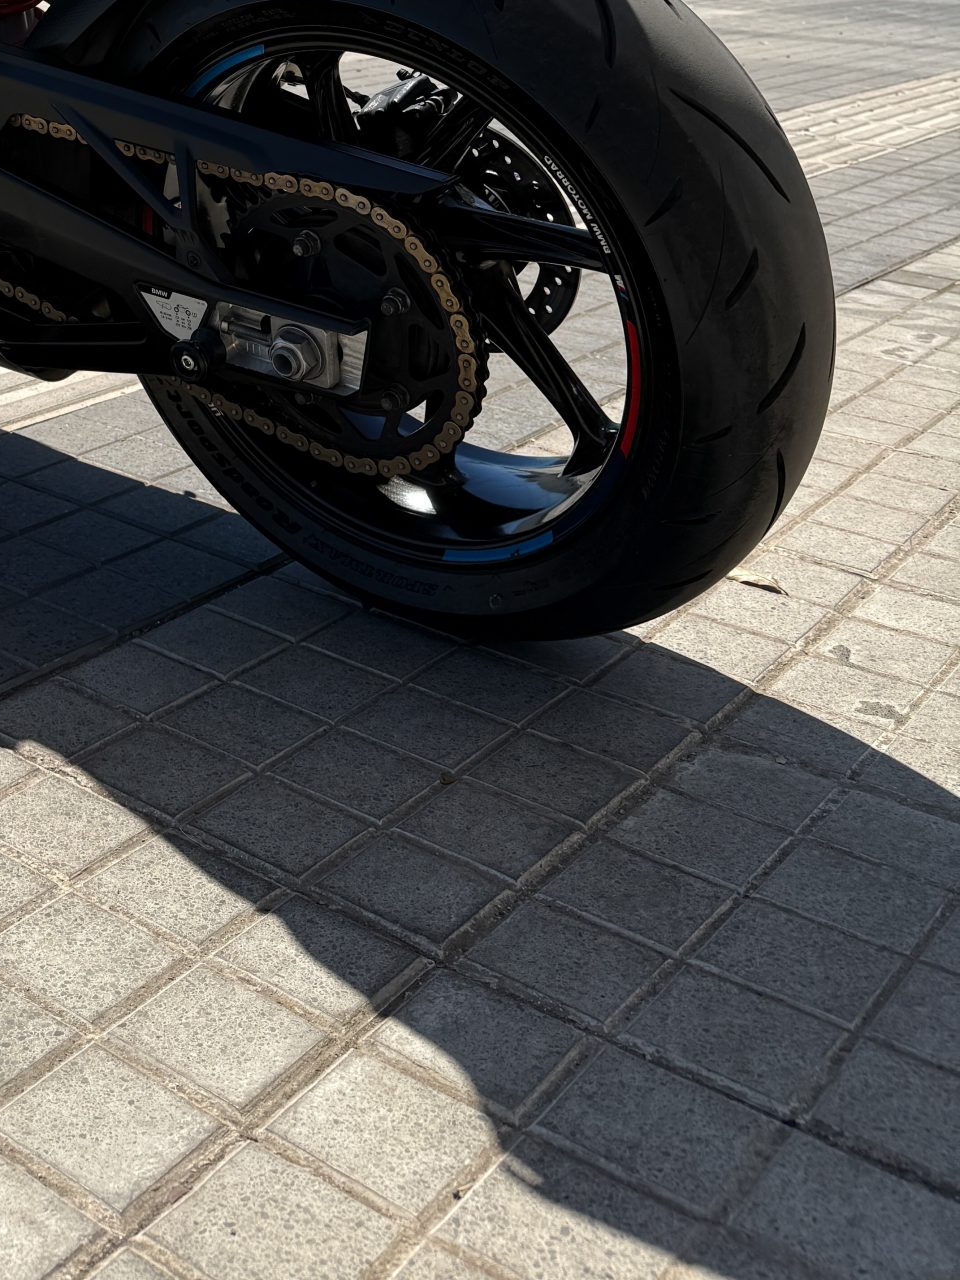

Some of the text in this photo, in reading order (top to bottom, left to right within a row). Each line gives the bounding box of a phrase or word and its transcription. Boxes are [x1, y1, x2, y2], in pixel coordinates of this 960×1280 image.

[544, 155, 612, 255] BMW MOTORRAD
[151, 287, 168, 298] BMW
